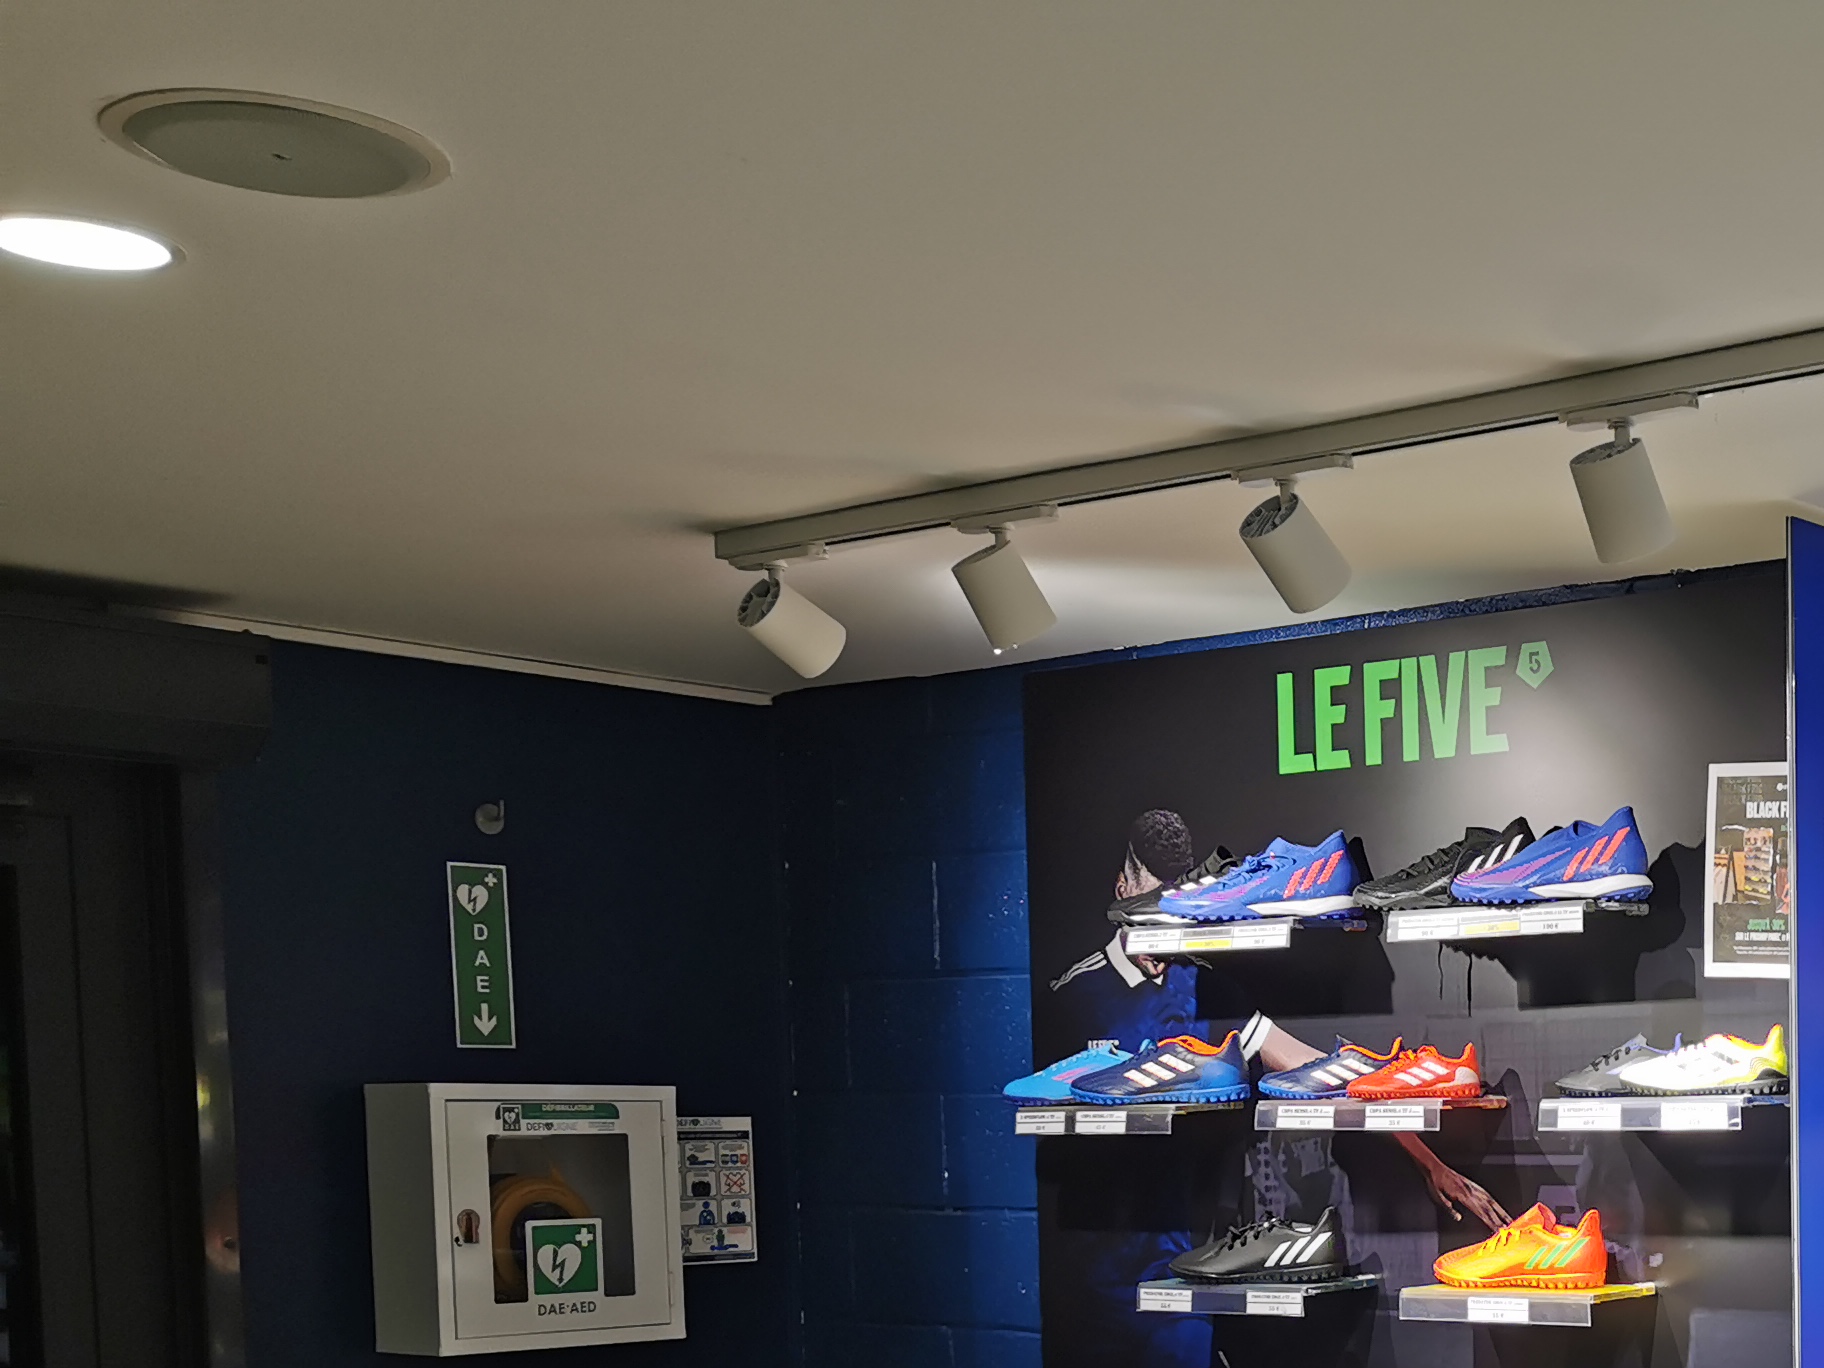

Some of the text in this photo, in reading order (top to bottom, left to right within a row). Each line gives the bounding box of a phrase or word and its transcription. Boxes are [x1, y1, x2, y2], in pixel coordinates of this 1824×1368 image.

[1276, 665, 1352, 775] LE
[1364, 645, 1509, 766] FIVE
[1746, 801, 1779, 818] BLACK
[473, 923, 491, 993] DAE
